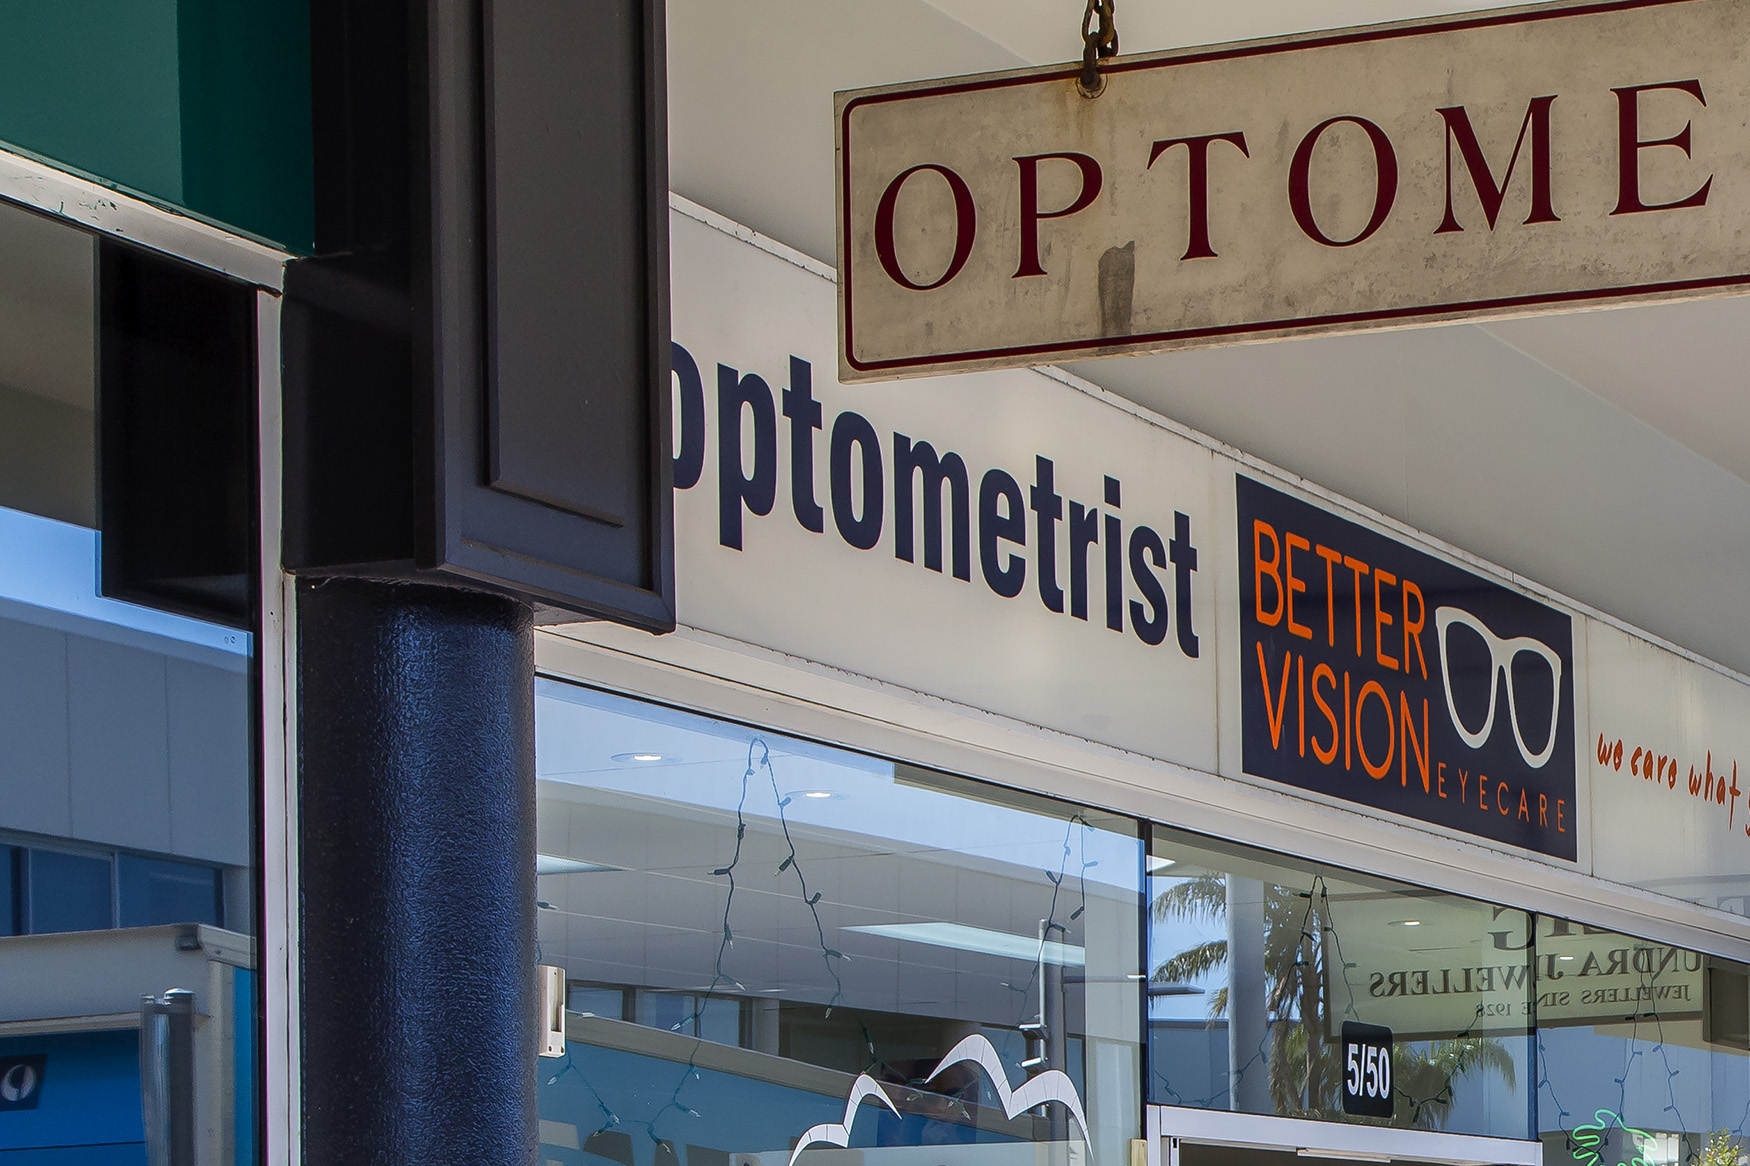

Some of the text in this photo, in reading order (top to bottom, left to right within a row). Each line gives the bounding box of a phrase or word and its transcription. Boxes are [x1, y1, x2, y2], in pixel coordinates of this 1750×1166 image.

[671, 341, 1199, 659] optometrist
[1254, 519, 1428, 680] BETTER
[1257, 641, 1430, 794] VISION
[1438, 762, 1565, 832] EYECARE
[1597, 732, 1623, 772] we
[1631, 746, 1677, 790] care
[1689, 749, 1741, 831] what
[1347, 1043, 1390, 1099] 5/50
